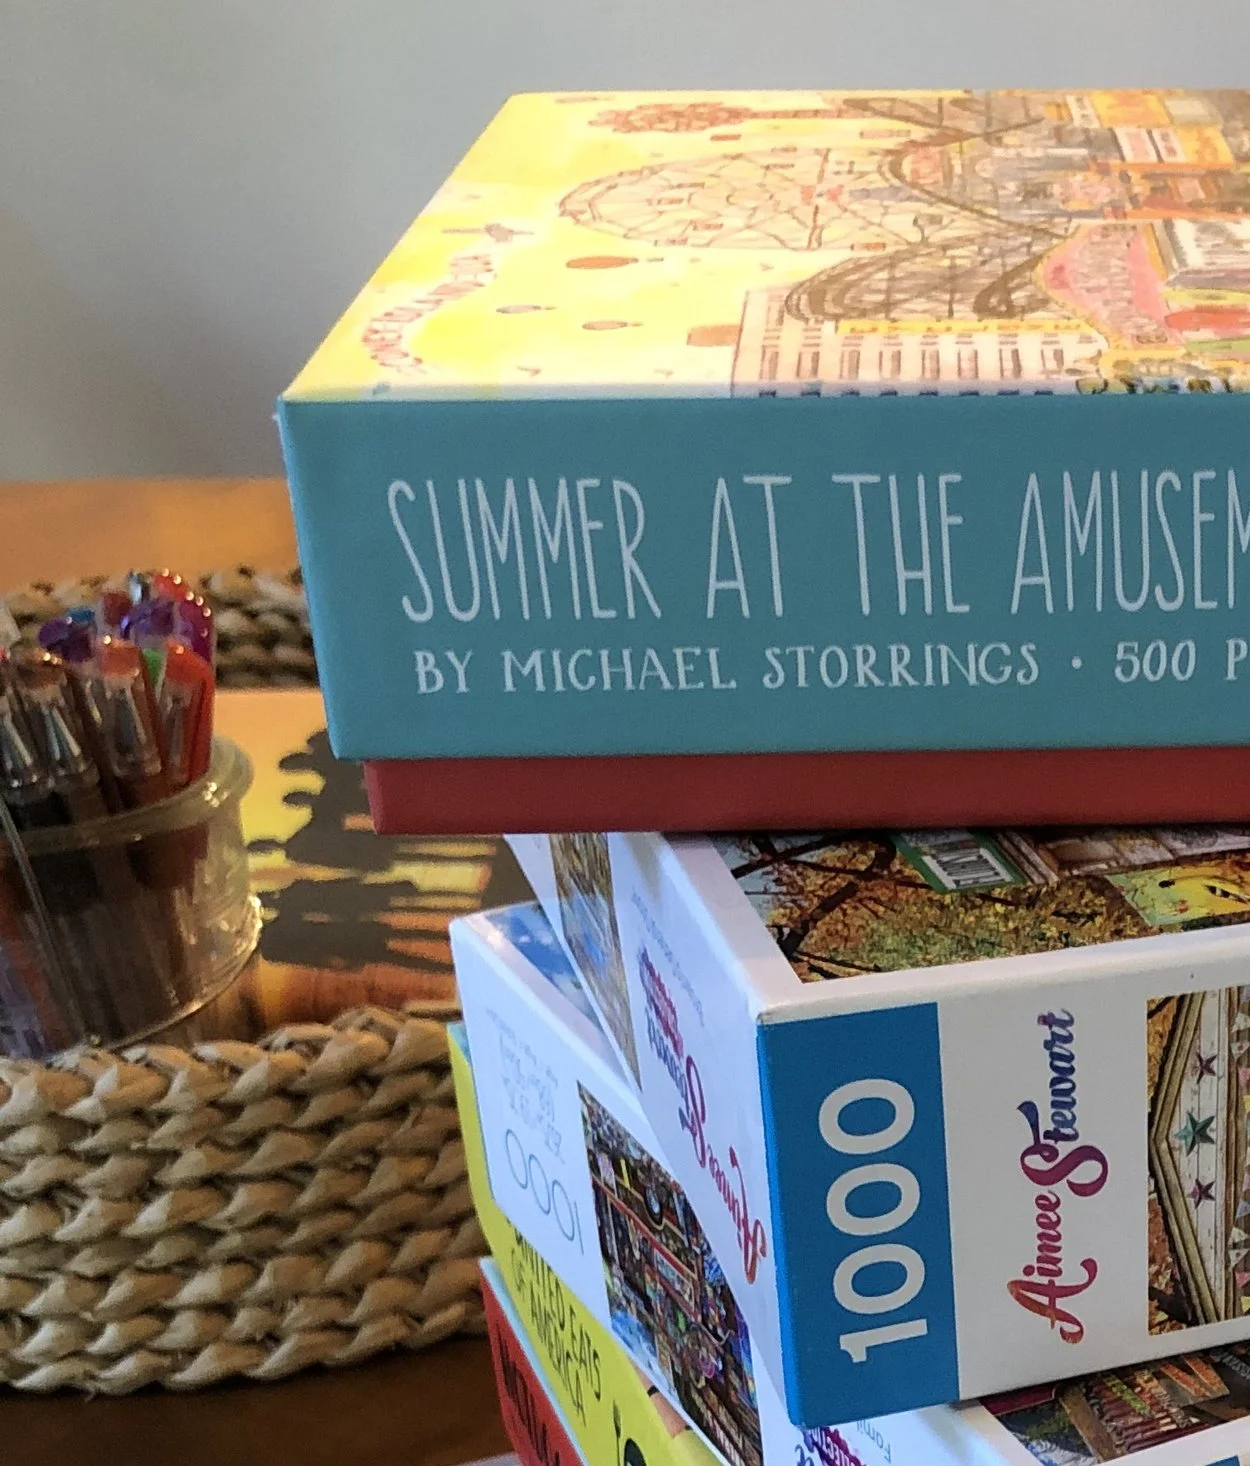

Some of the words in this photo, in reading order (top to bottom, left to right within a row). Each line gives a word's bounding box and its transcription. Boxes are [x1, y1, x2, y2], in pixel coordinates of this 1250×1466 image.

[387, 477, 662, 624] SUMMER
[705, 474, 792, 620] AT
[831, 471, 970, 618] THE
[413, 650, 474, 694] BY
[502, 646, 738, 692] MICHAEL
[762, 641, 1041, 690] STORRINGS
[1112, 638, 1197, 683] 500
[1017, 1008, 1109, 1198] Stewart
[503, 1127, 585, 1256] 1000
[818, 1077, 928, 1364] 1000
[1006, 1191, 1098, 1345] Aimee
[529, 1280, 587, 1428] AMERICA
[569, 1304, 601, 1402] EATS
